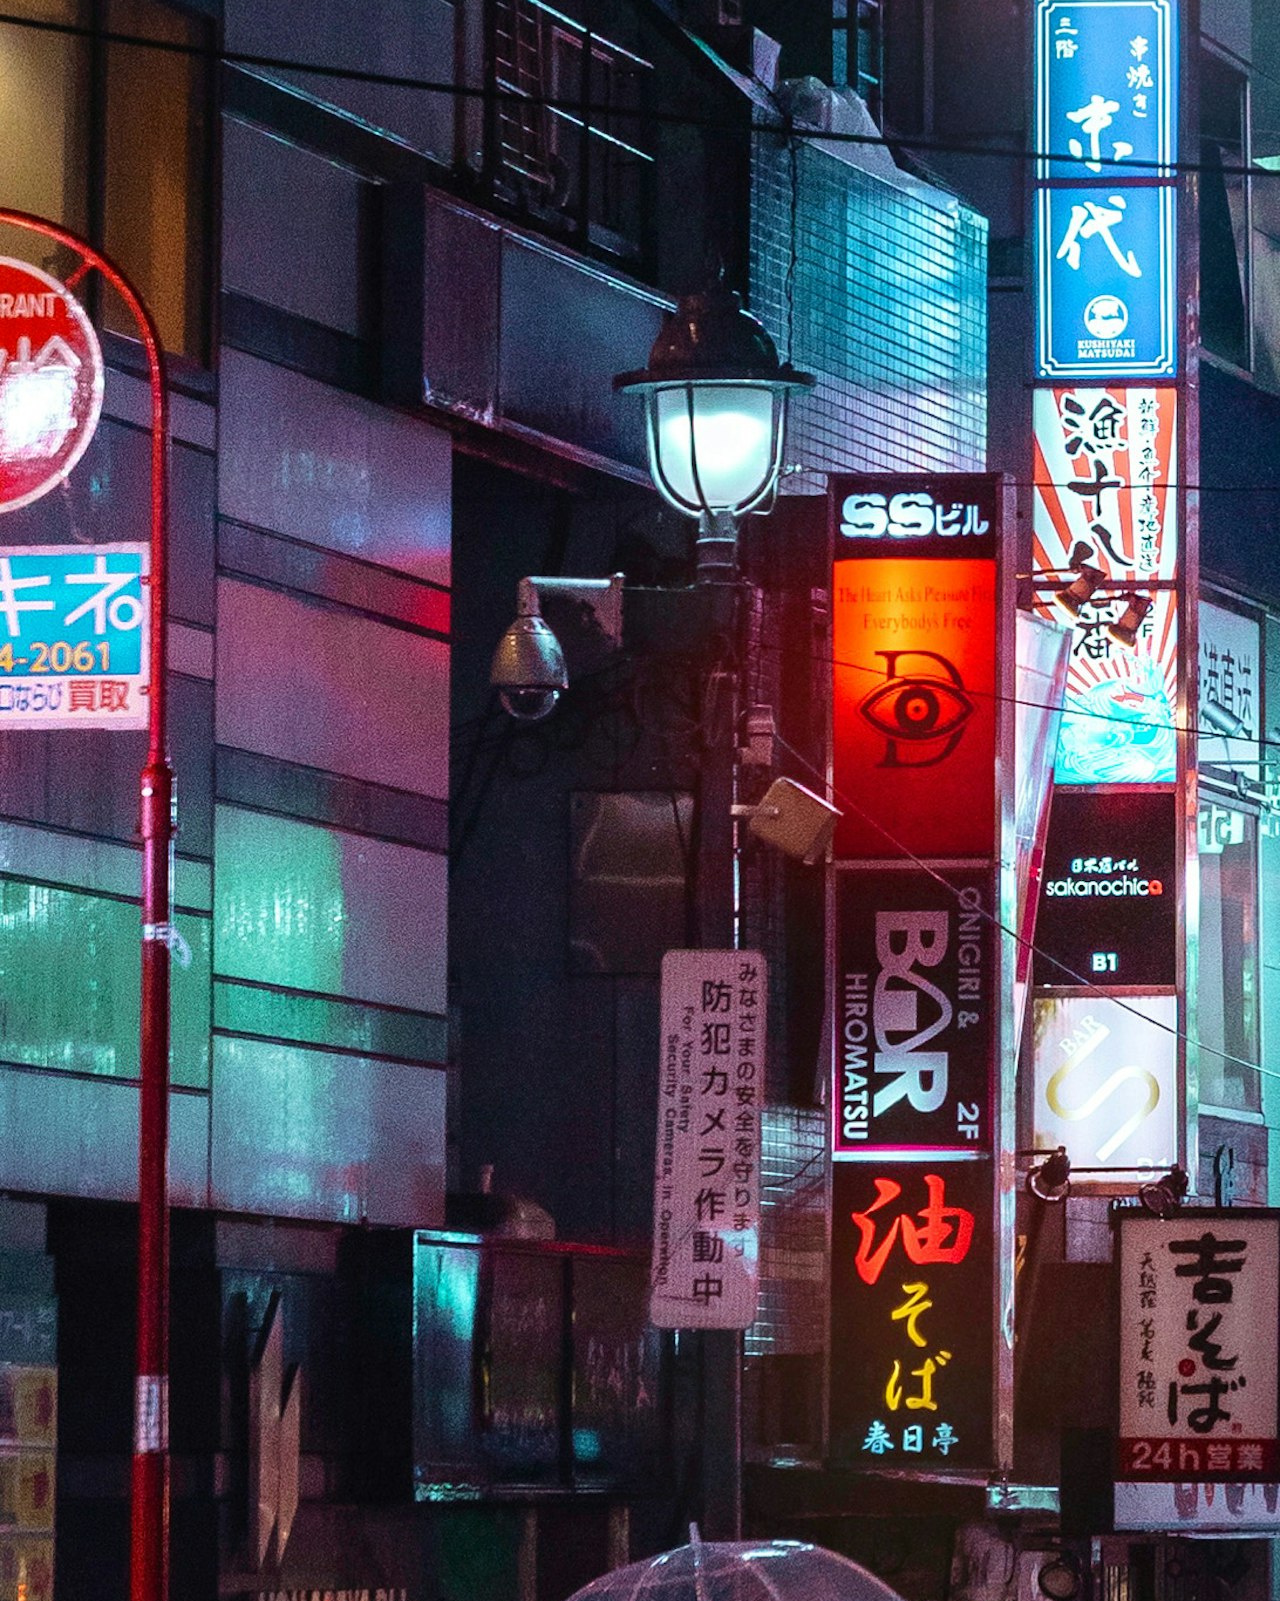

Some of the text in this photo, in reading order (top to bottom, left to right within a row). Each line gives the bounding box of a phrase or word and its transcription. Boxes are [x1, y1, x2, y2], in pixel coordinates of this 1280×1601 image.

[1125, 35, 1154, 119] 串焼き
[1077, 339, 1136, 349] KUSHIYAKI
[1077, 348, 1136, 359] MATSUDAI
[839, 492, 990, 539] SSビル
[68, 679, 130, 712] 買取
[1045, 874, 1164, 898] sakanochica
[956, 885, 980, 1028] ONIGIRI &
[1091, 952, 1119, 972] B1
[843, 972, 869, 1140] HIROMATSU
[732, 962, 758, 1258] みなさまの安全を守ります
[956, 1100, 980, 1140] 2F
[691, 979, 733, 1306] 防犯カメラ作動中
[852, 1174, 976, 1412] 油そば
[1166, 1231, 1248, 1435] 吉そば
[861, 1421, 960, 1457] 春日亭
